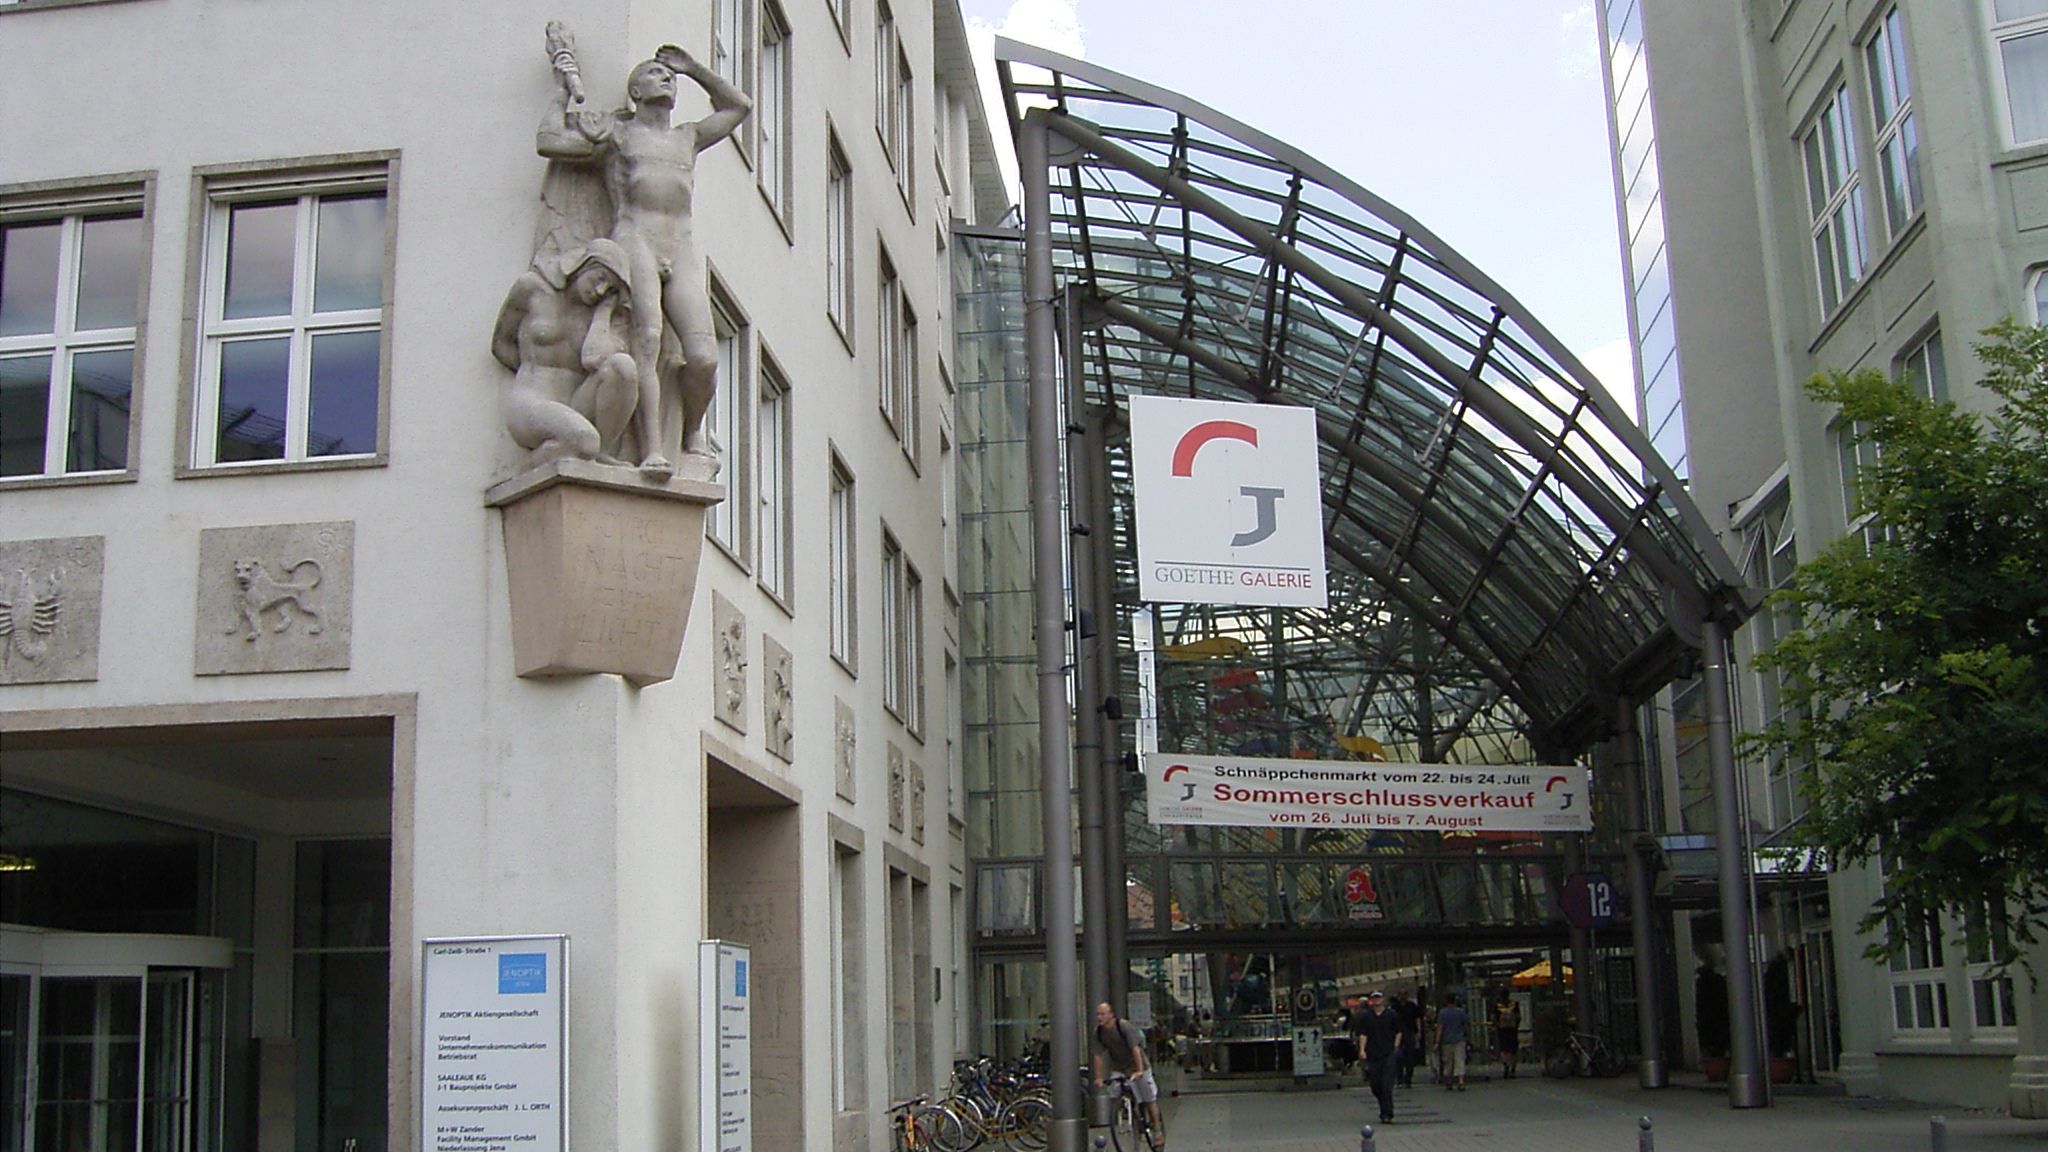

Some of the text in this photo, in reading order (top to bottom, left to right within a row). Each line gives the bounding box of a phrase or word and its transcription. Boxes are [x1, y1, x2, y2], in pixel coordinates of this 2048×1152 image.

[1155, 567, 1311, 588] GOETHE GALERIE
[1214, 765, 1530, 785] Schnäppchenmarkt vom 22. bis 24. Juli
[1213, 783, 1535, 809] Sommerschlussverkauf
[1269, 812, 1483, 828] vom 26. Juli bis 7. August
[1587, 882, 1611, 917] 12
[474, 1009, 539, 1018] Aktiengesellschaft
[437, 1073, 487, 1081] SAALEAUE KG
[449, 1084, 492, 1092] Bauprojekte
[438, 1103, 509, 1113] Assekuranzgeschäft
[459, 1125, 485, 1133] Zander
[437, 1135, 462, 1143] Facility
[463, 1134, 512, 1142] Management
